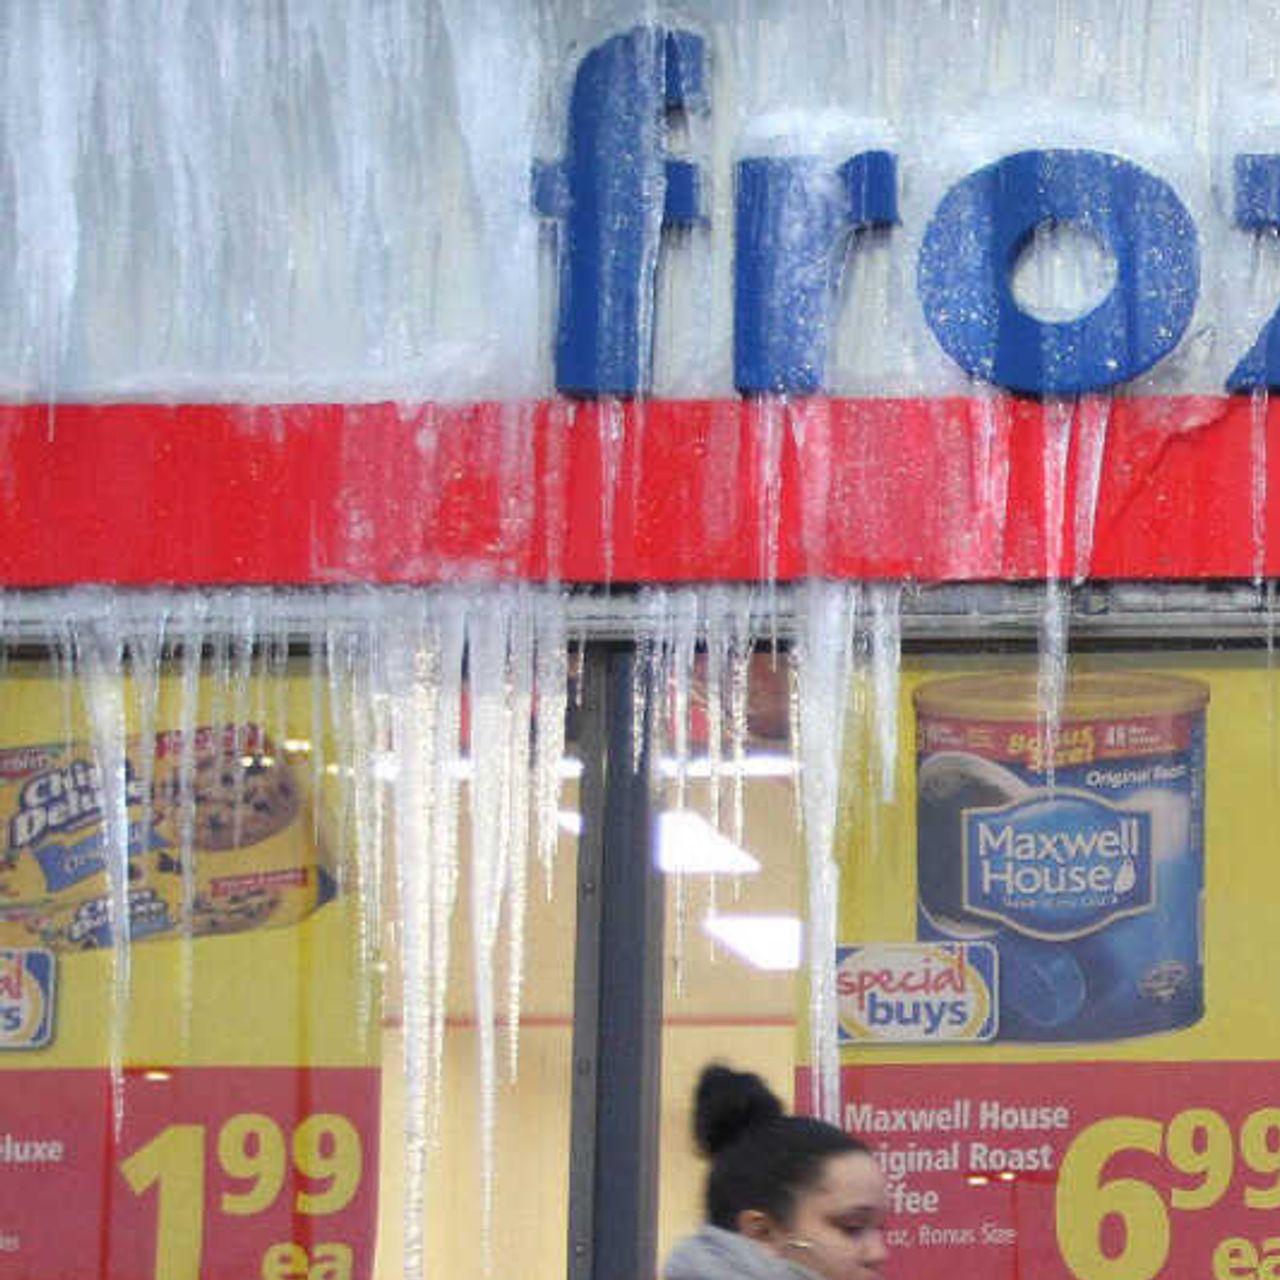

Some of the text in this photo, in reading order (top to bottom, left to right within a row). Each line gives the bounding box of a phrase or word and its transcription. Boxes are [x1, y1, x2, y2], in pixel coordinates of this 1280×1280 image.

[1086, 768, 1150, 789] Original
[978, 818, 1139, 862] Maxwell
[982, 861, 1111, 895] House
[837, 943, 965, 1011] special
[868, 992, 968, 1034] buys
[844, 1099, 1070, 1132] Maxwell House
[969, 1141, 1054, 1171] Roast
